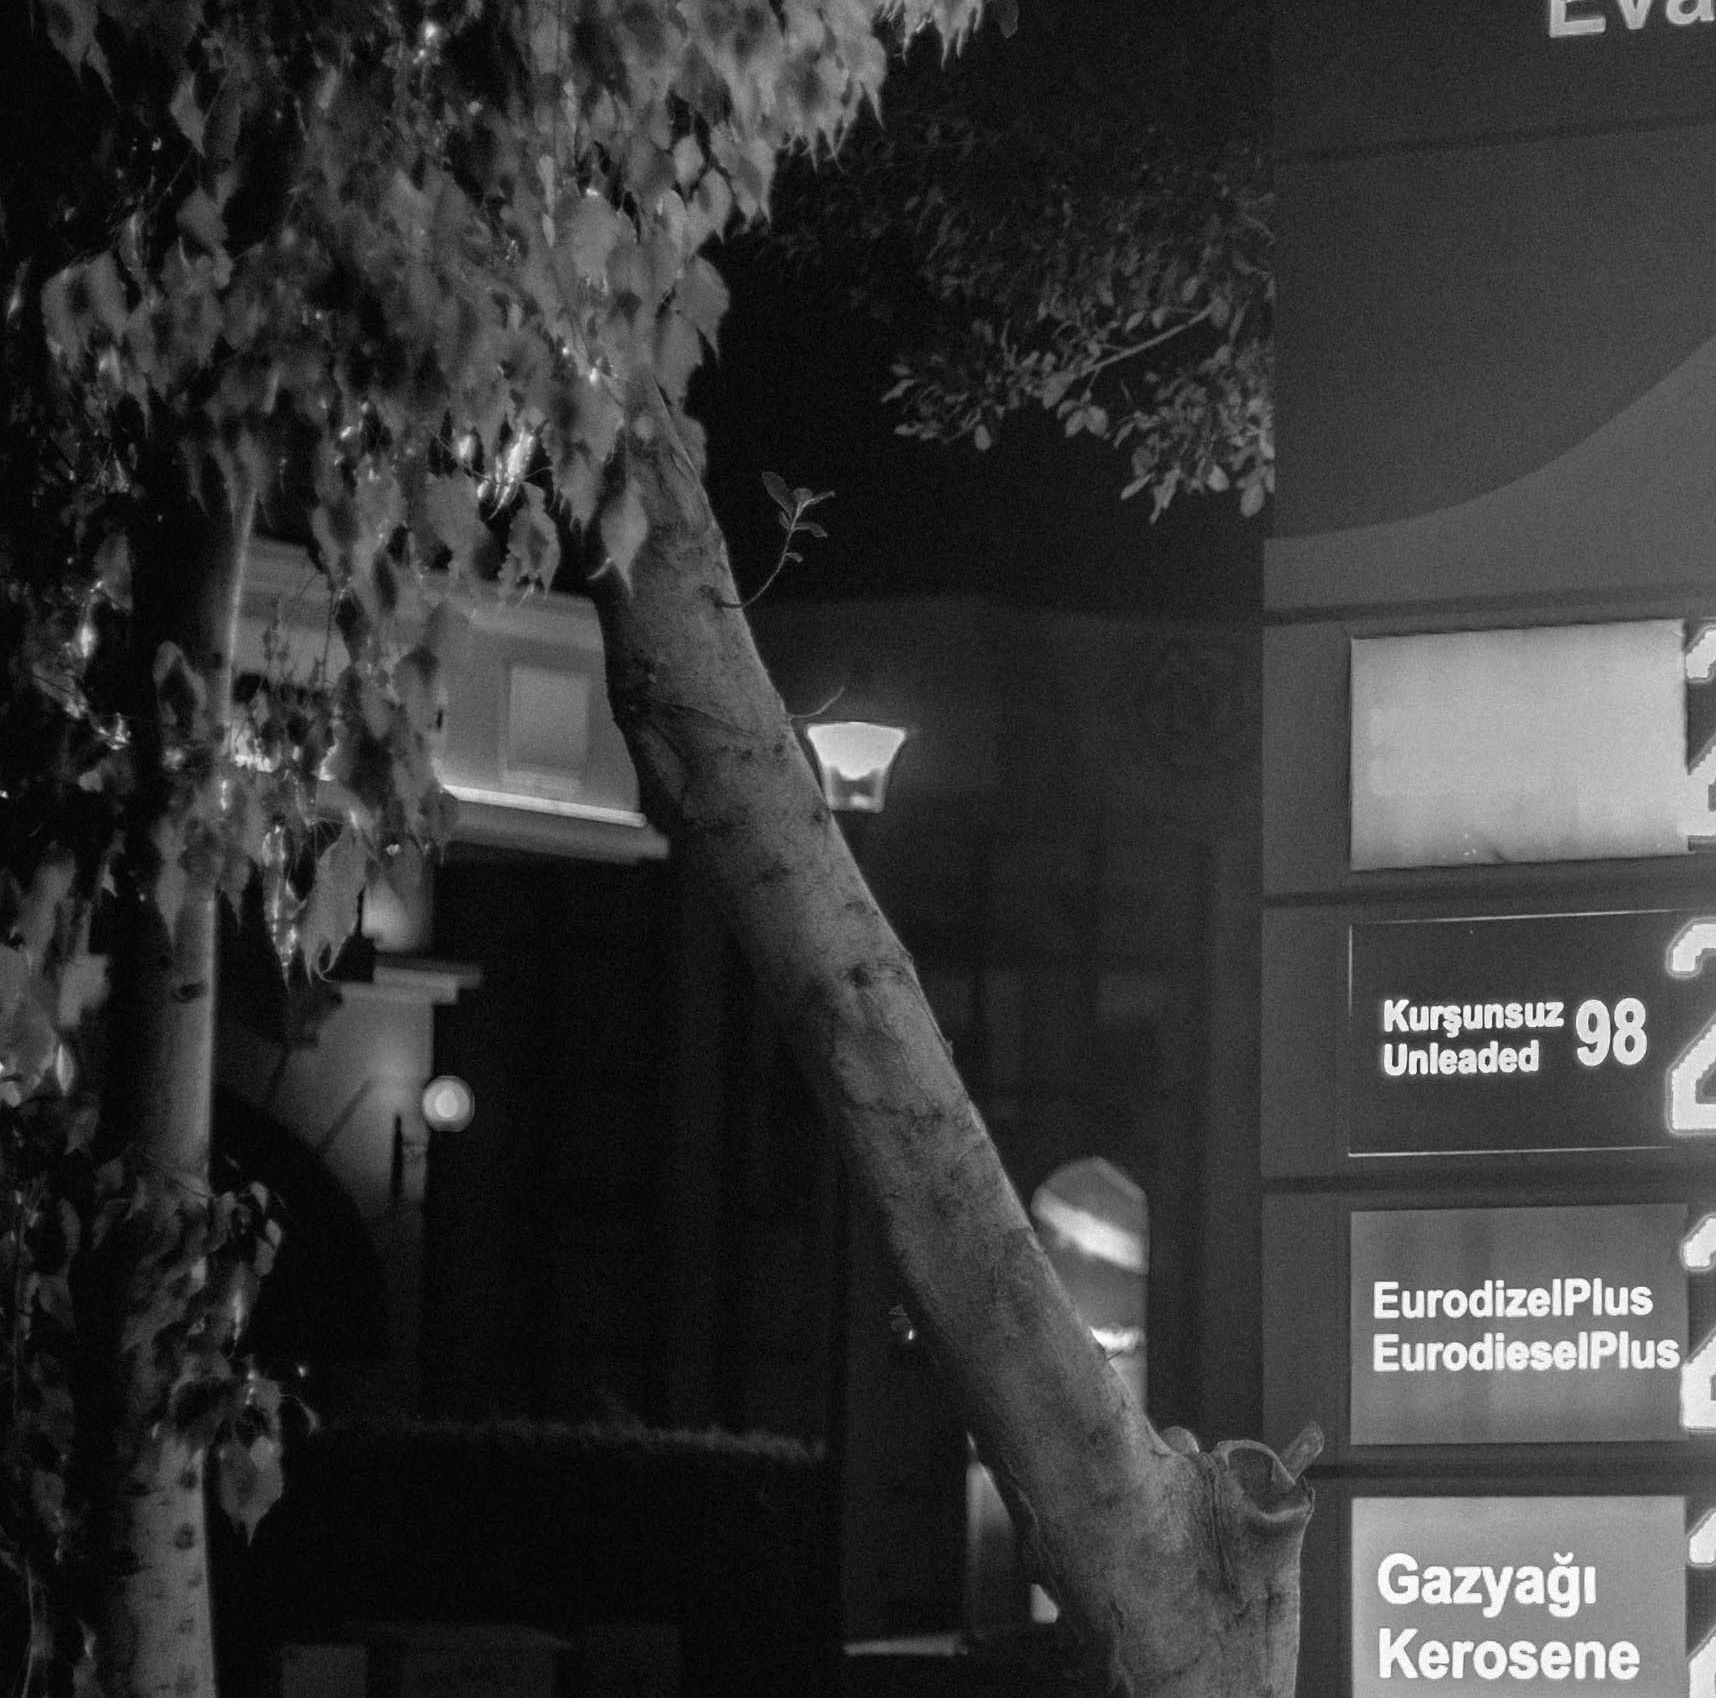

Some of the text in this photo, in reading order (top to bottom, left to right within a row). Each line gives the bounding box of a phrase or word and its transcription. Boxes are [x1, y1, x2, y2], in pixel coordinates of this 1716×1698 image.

[1383, 998, 1566, 1038] Kurşunsuz
[1575, 997, 1649, 1067] 98
[1383, 1039, 1541, 1076] Unleaded
[1373, 1277, 1655, 1319] EurodizelPlus
[1373, 1330, 1681, 1373] EurodieselPlus
[1376, 1552, 1598, 1619] Gazyağı
[1377, 1626, 1641, 1682] Kerosene
